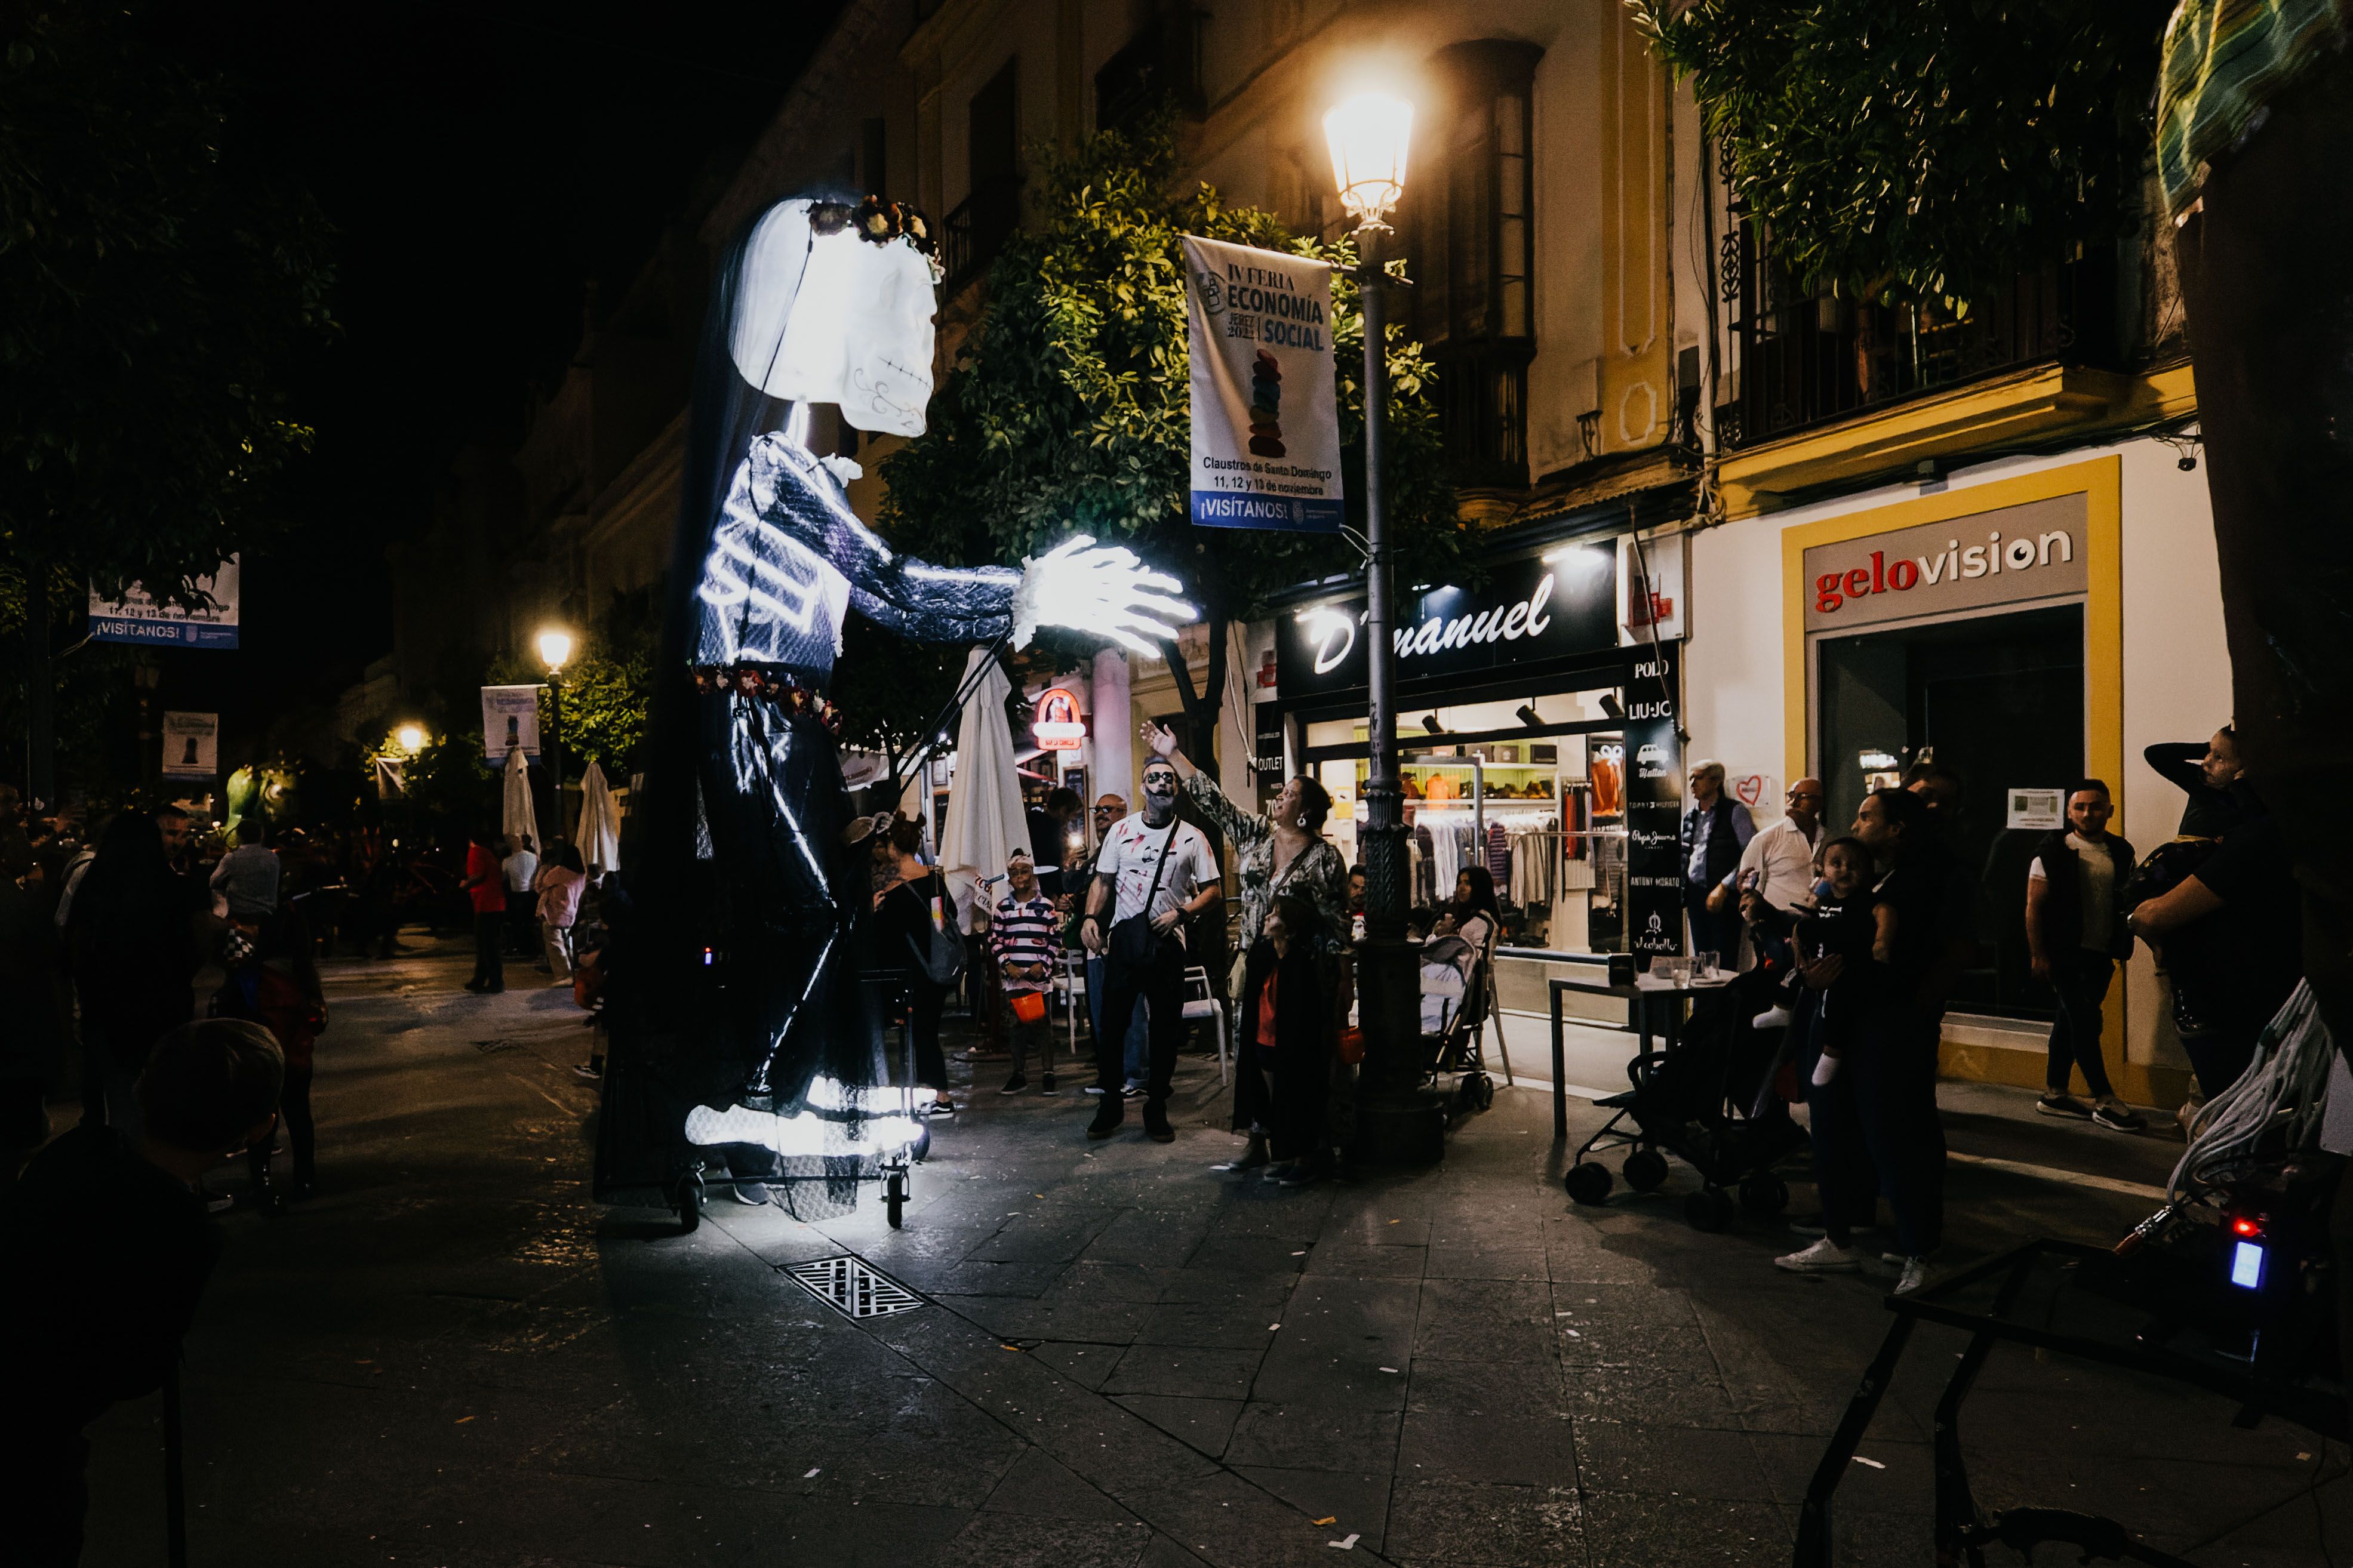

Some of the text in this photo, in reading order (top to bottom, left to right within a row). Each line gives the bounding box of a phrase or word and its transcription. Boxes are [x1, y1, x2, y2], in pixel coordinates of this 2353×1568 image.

[1247, 267, 1294, 291] FERIA
[1228, 284, 1324, 325] ECONOMÍA
[1264, 319, 1324, 351] SOCIAL
[1203, 457, 1251, 471] Claustros
[1253, 463, 1263, 472] de
[1291, 466, 1332, 482] Domingo
[1214, 476, 1228, 489] 11,
[1232, 476, 1243, 488] 12
[1245, 479, 1252, 492] y
[1278, 482, 1324, 495] noviembre
[1201, 496, 1288, 519] ¡VISÍTANOS!
[1815, 529, 2074, 614] gelovision
[1259, 756, 1283, 771] OUTLET
[1631, 876, 1680, 888] ANTONY MORATO
